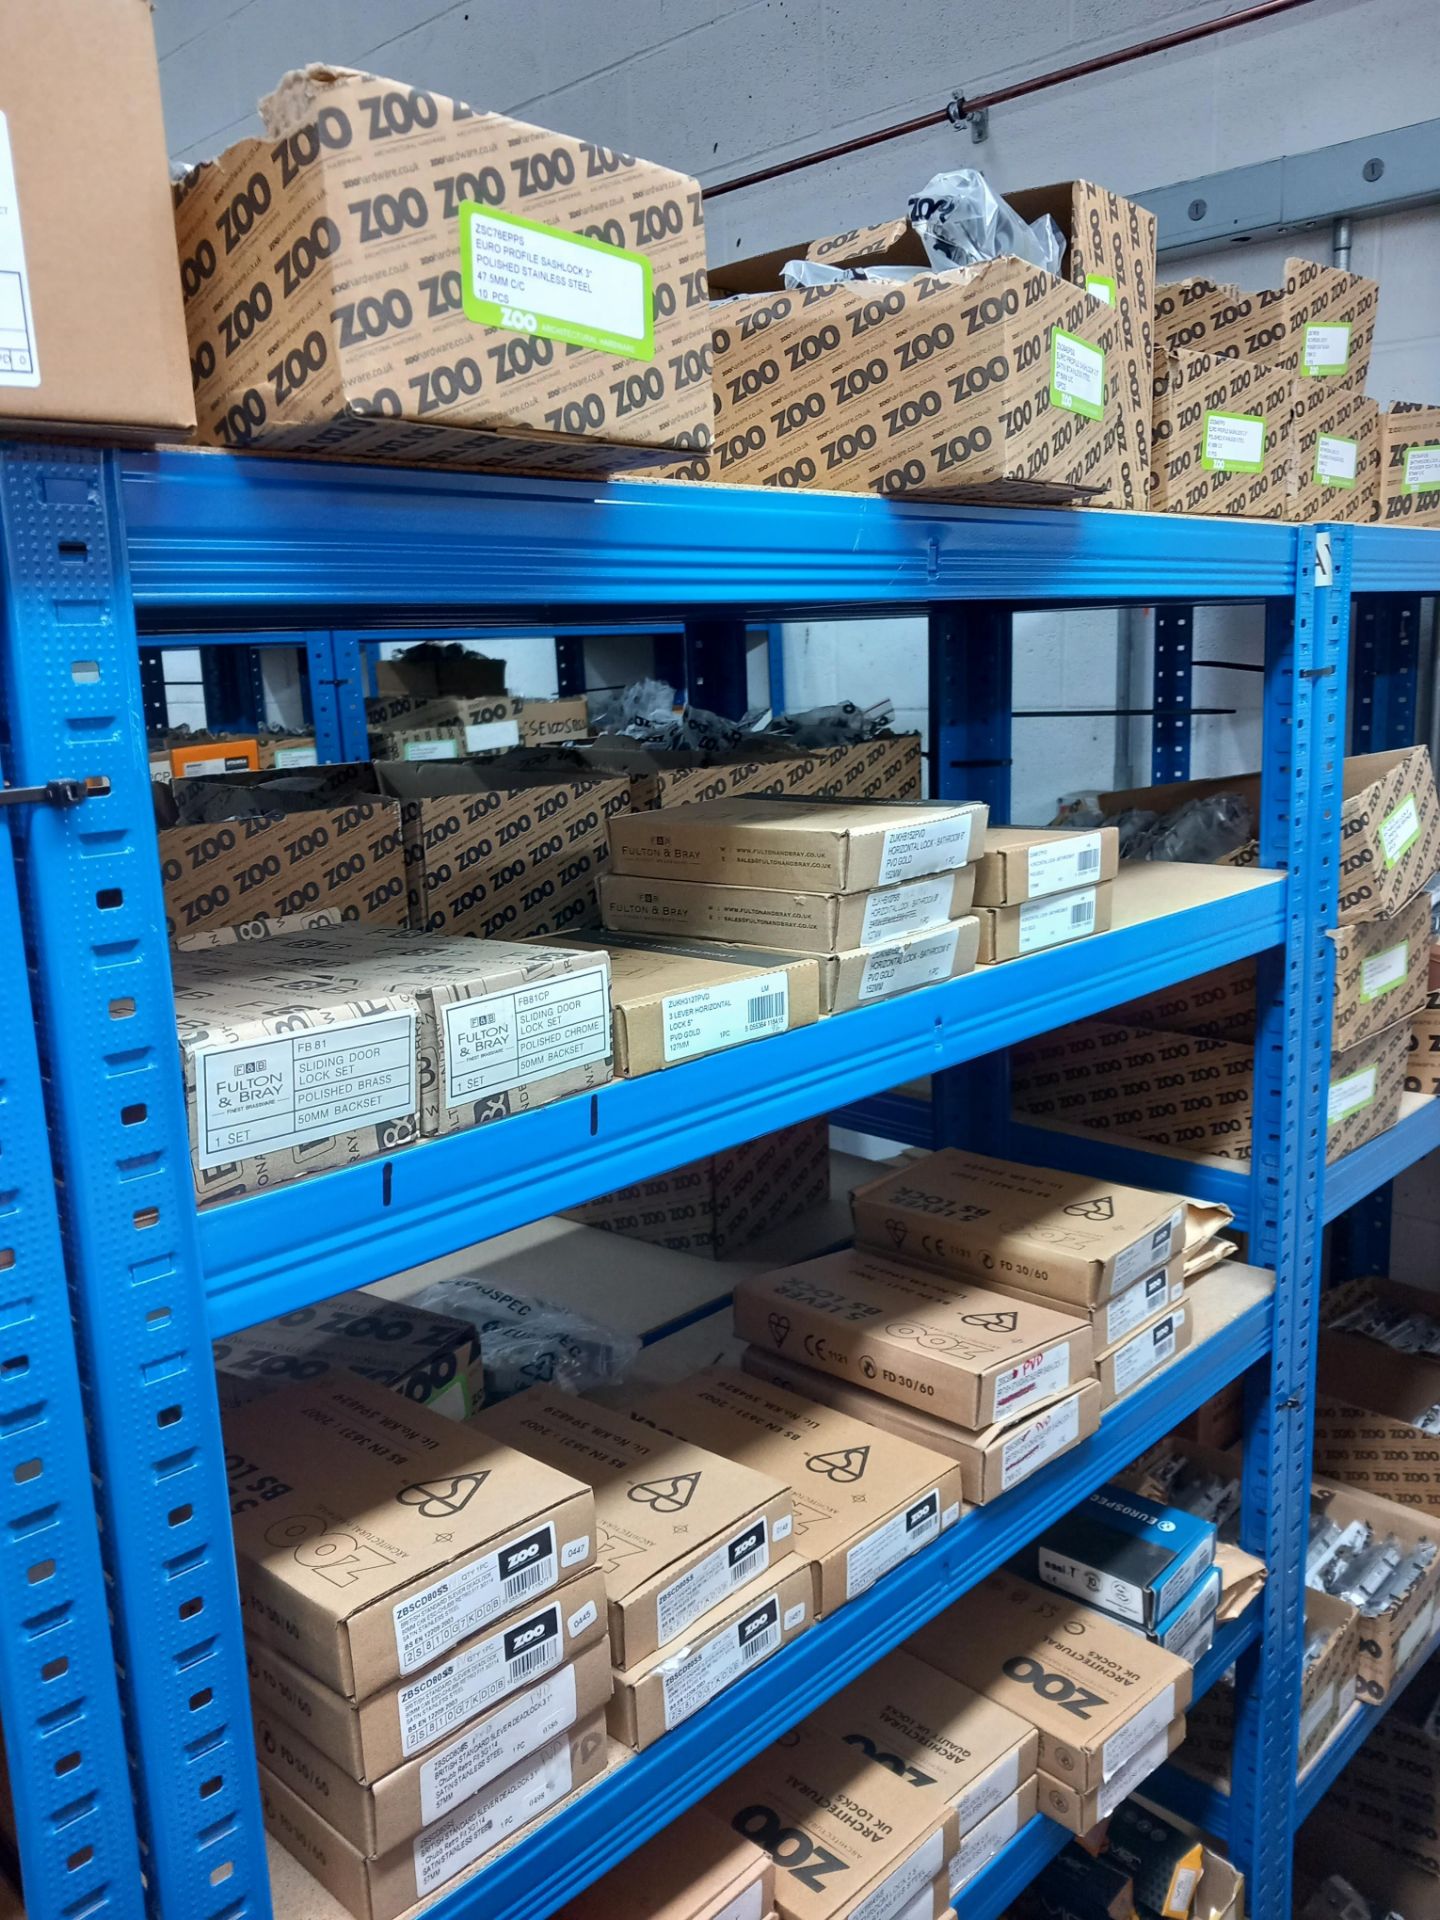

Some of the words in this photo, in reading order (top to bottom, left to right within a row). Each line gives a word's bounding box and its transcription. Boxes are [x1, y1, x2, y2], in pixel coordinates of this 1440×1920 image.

[358, 89, 438, 139] ZOO
[511, 148, 575, 197] ZOO
[216, 172, 271, 254] ZOO
[348, 187, 429, 243] ZOO
[629, 200, 683, 247] ZOO
[476, 239, 501, 254] EURO
[503, 246, 539, 264] PROFILE
[541, 257, 583, 275] SASHLOCK
[1113, 232, 1126, 288] ZOO
[476, 254, 519, 274] POLISHED
[522, 267, 566, 286] STAINLESS
[568, 279, 593, 293] STEEL
[510, 279, 525, 291] C/C
[479, 288, 488, 299] 10
[492, 292, 509, 304] PCS
[218, 282, 272, 358] ZOO
[331, 289, 413, 348] ZOO
[501, 307, 537, 333] ZOO
[736, 298, 791, 342] ZOO
[846, 291, 906, 338] ZOO
[961, 288, 1018, 336] ZOO
[1210, 300, 1251, 330] ZOO
[1311, 299, 1329, 321] ZOO
[784, 325, 840, 372] ZOO
[1013, 335, 1041, 372] ZOO
[268, 331, 327, 406] ZOO
[726, 359, 780, 405] ZOO
[830, 358, 888, 406] ZOO
[948, 355, 1009, 404] ZOO
[409, 357, 482, 415] ZOO
[610, 367, 664, 418] ZOO
[1230, 375, 1250, 399] ZOO
[771, 392, 825, 439] ZOO
[882, 390, 942, 437] ZOO
[820, 424, 876, 470] ZOO
[930, 426, 991, 473] ZOO
[1386, 493, 1411, 518] ZOO
[469, 705, 506, 725] ZOO
[867, 744, 886, 766] ZOO
[496, 814, 531, 847] ZOO
[455, 839, 492, 872] ZOO
[622, 846, 661, 858] FULTON
[664, 849, 671, 857] &
[675, 849, 700, 859] BRAY
[887, 840, 919, 858] HORIZONTAL
[920, 838, 933, 849] LOCK
[233, 855, 281, 895] ZOO
[323, 853, 365, 891] ZOO
[1340, 849, 1374, 875] ZOO
[609, 903, 648, 913] FULTON
[652, 906, 658, 914] &
[662, 906, 688, 915] BRAY
[518, 991, 550, 1006] FB81CP
[520, 1007, 554, 1024] SLIDING
[557, 1000, 581, 1013] DOOR
[673, 1008, 693, 1018] LEVER
[694, 999, 731, 1013] HORIZONTAL
[458, 1024, 508, 1045] FULTON
[520, 1022, 543, 1035] LOCK
[547, 1016, 562, 1027] SET
[520, 1031, 561, 1052] POLISHED
[564, 1021, 599, 1038] CHROME
[669, 1020, 686, 1031] LOCK
[669, 1032, 682, 1041] PVD
[683, 1028, 700, 1038] GOLD
[460, 1047, 470, 1056] &
[475, 1035, 509, 1052] BRAY
[520, 1055, 545, 1070] 50MM
[548, 1043, 585, 1061] BACKSET
[670, 1040, 689, 1051] 127MM
[299, 1055, 344, 1073] SLIDING
[350, 1048, 380, 1063] DOOR
[216, 1072, 283, 1096] FULTON
[298, 1082, 353, 1103] POLISHED
[358, 1074, 391, 1090] BRASS
[299, 1069, 330, 1085] LOCK
[336, 1065, 355, 1076] SET
[458, 1082, 461, 1091] 1
[467, 1076, 484, 1088] SET
[219, 1097, 232, 1108] &
[239, 1084, 283, 1103] BRAY
[298, 1108, 329, 1124] 50MM
[334, 1096, 382, 1115] BACKSET
[215, 1137, 220, 1147] 1
[227, 1130, 250, 1145] SET
[1209, 1120, 1241, 1136] ZOO
[883, 1370, 897, 1382] FD
[899, 1373, 934, 1396] 30/60
[766, 1423, 783, 1433] EN
[785, 1430, 801, 1441] BS
[589, 1449, 609, 1461] EN
[612, 1459, 626, 1469] BS
[1089, 1494, 1159, 1525] EUROSPEC
[506, 1541, 539, 1569] ZOO
[734, 1532, 756, 1557] ZOO
[396, 1583, 448, 1619] ZBSCD80SS
[461, 1569, 475, 1581] QTY
[421, 1597, 447, 1616] STANDARD
[404, 1640, 413, 1650] BS
[414, 1634, 423, 1644] EN
[512, 1621, 545, 1650] ZOO
[1042, 1635, 1135, 1687] ARCHITECTURAL
[1087, 1651, 1122, 1672] LOCKS
[400, 1665, 454, 1703] ZBSCD80SS
[467, 1650, 481, 1663] QTY
[1002, 1656, 1109, 1720] ZOO
[1123, 1669, 1141, 1681] UK
[425, 1679, 452, 1699] STANDARD
[408, 1722, 417, 1733] BS
[418, 1717, 426, 1727] EN
[879, 1712, 966, 1765] ARCHITECTURAL
[919, 1723, 931, 1737] UK
[434, 1757, 458, 1781] BRITISH
[458, 1736, 489, 1763] STANDARD
[512, 1700, 542, 1726] DEADLOCK
[516, 1739, 525, 1752] PC
[934, 1732, 971, 1758] QUALITY
[435, 1780, 454, 1800] SATIN
[454, 1758, 485, 1786] STAINLESS
[486, 1745, 503, 1763] STEEL
[457, 1757, 472, 1774] Retro
[445, 1811, 476, 1840] STANDARD
[499, 1774, 529, 1801] DEADLOCK
[504, 1814, 512, 1826] PC
[786, 1775, 884, 1844] ARCHITECTURAL
[834, 1793, 872, 1820] LOCKS
[873, 1818, 893, 1836] UK
[422, 1856, 441, 1876] SATIN
[441, 1833, 473, 1862] STAINLESS
[731, 1804, 850, 1894] ZOO
